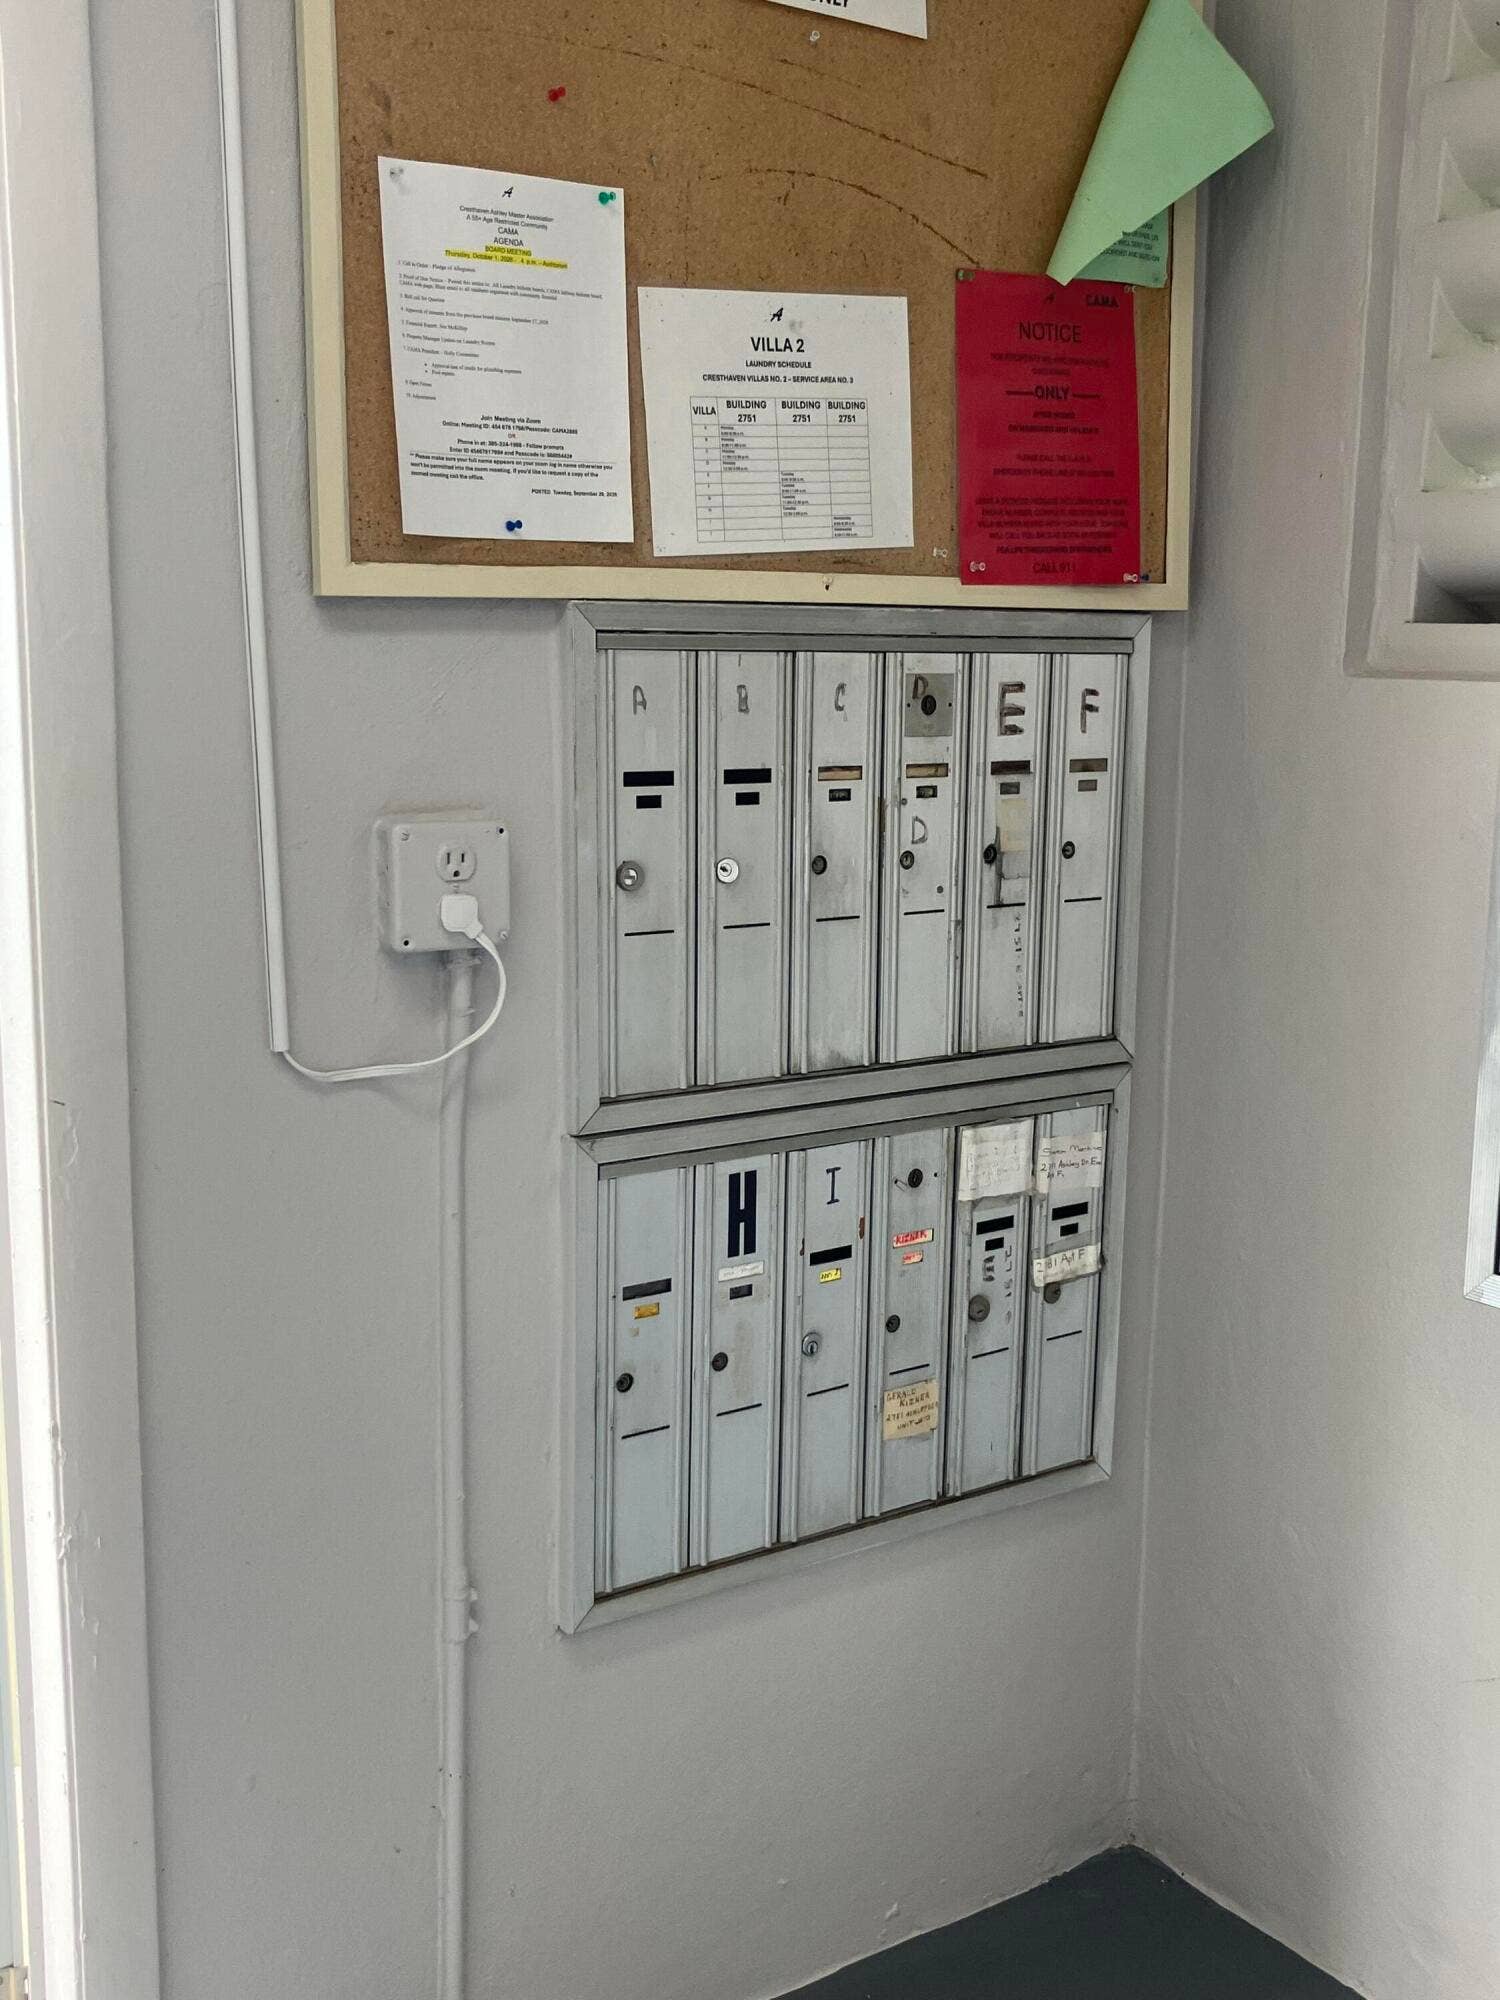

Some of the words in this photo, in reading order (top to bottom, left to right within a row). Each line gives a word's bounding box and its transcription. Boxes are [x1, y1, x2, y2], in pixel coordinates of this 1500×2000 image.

[497, 226, 519, 236] CAMA
[493, 236, 524, 247] AGENDA
[485, 245, 506, 254] BOARD
[506, 248, 532, 257] MEETING
[1018, 320, 1082, 343] NOTICE
[750, 336, 793, 352] VILLA
[796, 338, 805, 352] 2
[745, 360, 776, 368] LAUNDRY
[777, 361, 812, 369] SCHEDULE
[702, 374, 746, 382] CRESTHAVEN
[770, 375, 781, 383] NO.
[836, 376, 847, 384] NO.
[1034, 385, 1070, 400] ONLY
[692, 406, 716, 415] VILLA
[726, 400, 767, 409] BUILDING
[781, 401, 821, 410] BUILDING
[828, 401, 866, 410] BUILDING
[738, 414, 756, 423] 2751
[792, 414, 811, 423] 2751
[838, 414, 856, 423] 2751
[912, 674, 928, 699] D
[633, 685, 647, 715] A
[736, 684, 750, 714] B
[834, 683, 847, 712] C
[999, 681, 1026, 737] E
[1080, 688, 1100, 734] F
[911, 816, 928, 844] D
[727, 1169, 758, 1258] H
